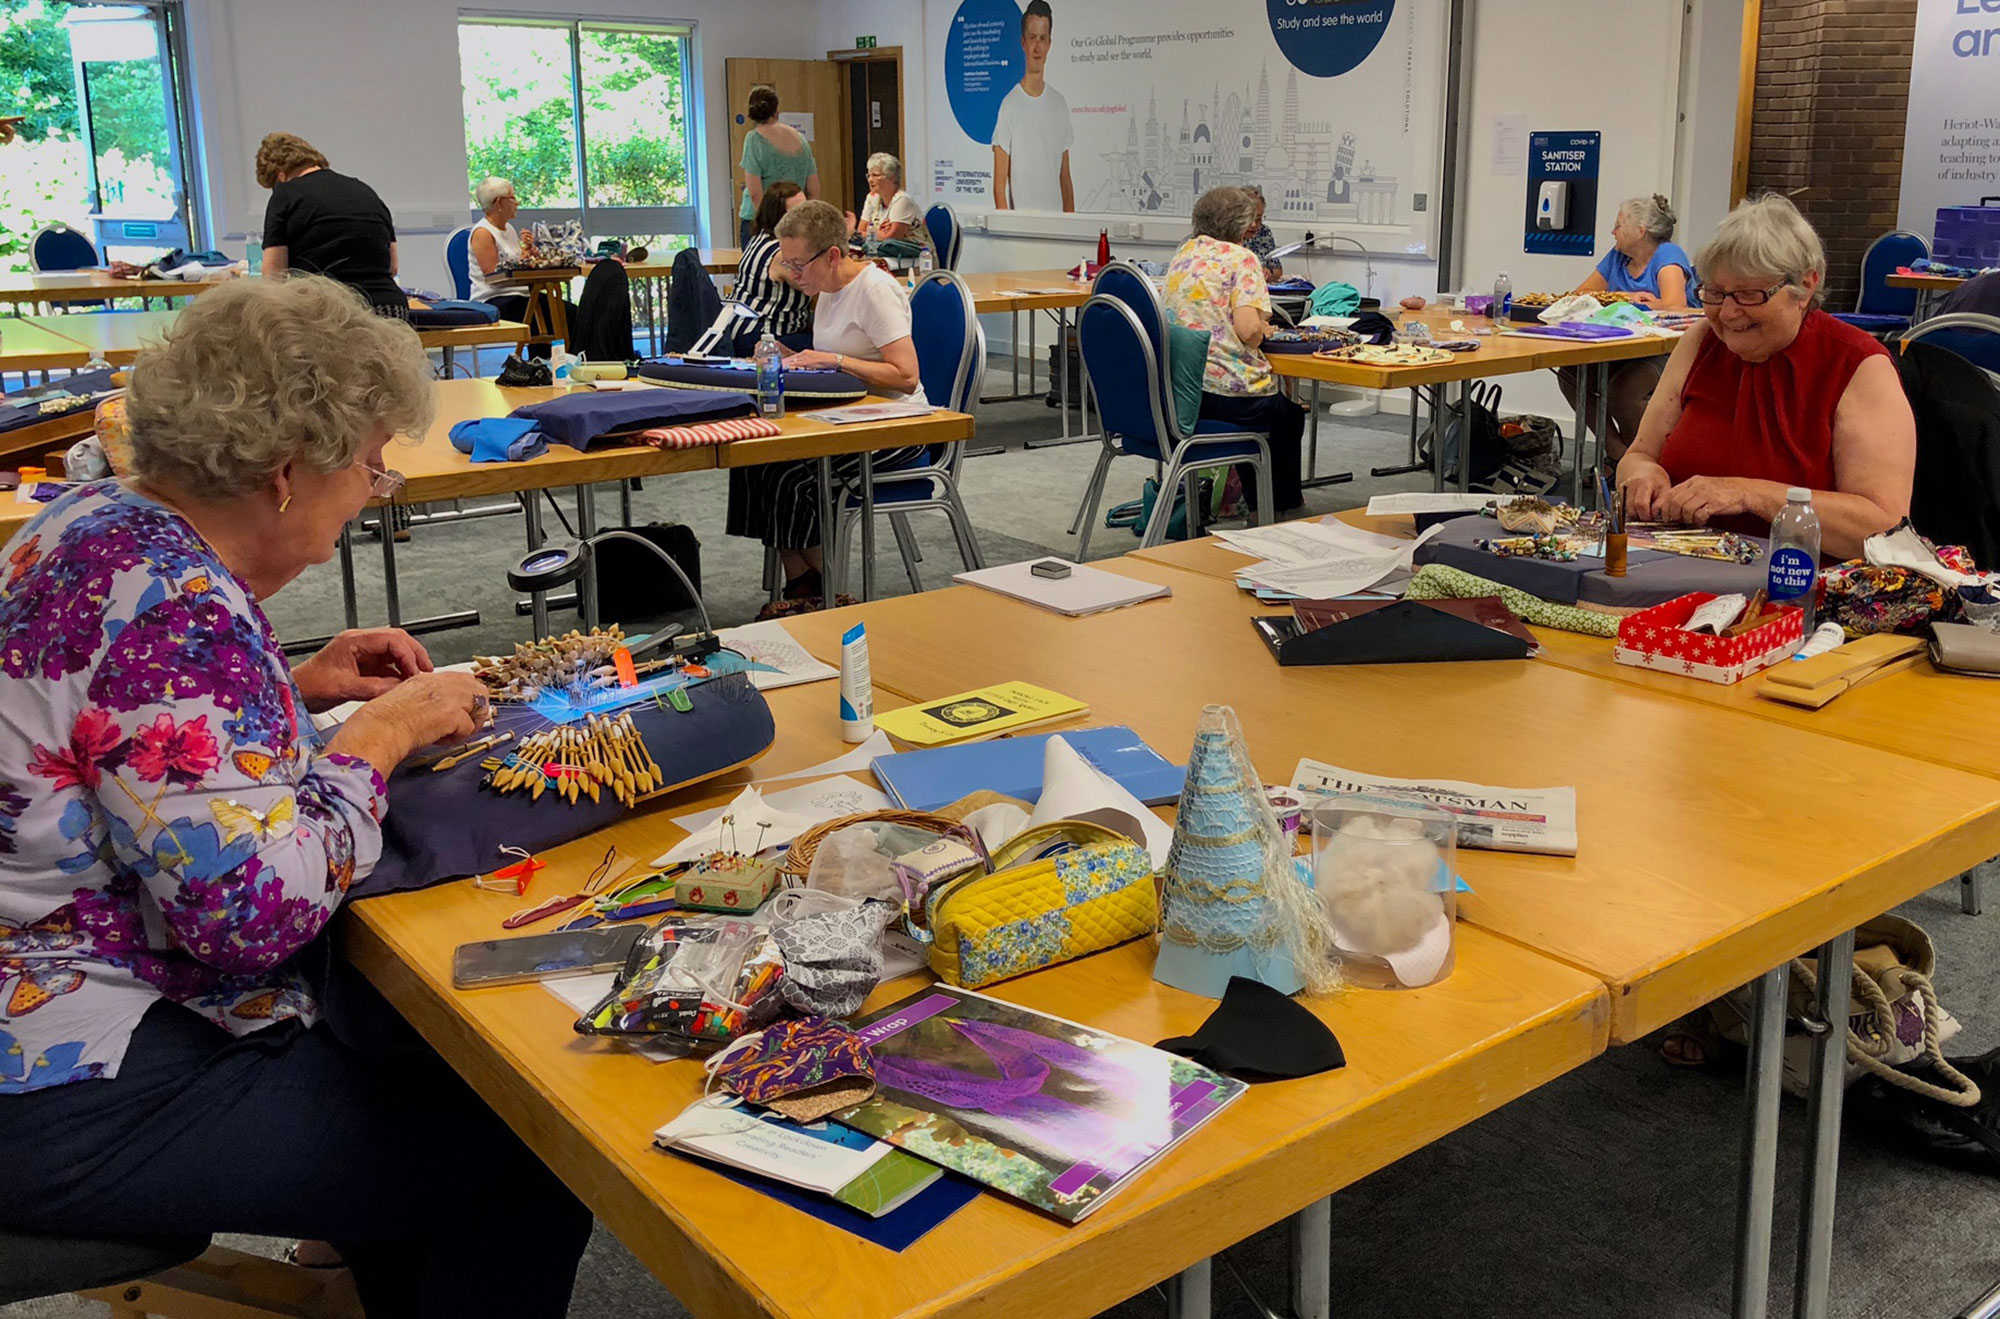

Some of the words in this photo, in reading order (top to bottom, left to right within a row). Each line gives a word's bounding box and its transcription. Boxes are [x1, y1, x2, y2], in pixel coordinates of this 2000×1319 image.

[1277, 17, 1300, 30] Study
[1303, 15, 1320, 27] and
[1322, 17, 1338, 26] see
[1340, 13, 1354, 25] the
[1357, 10, 1383, 23] world
[1071, 38, 1084, 48] Our
[1085, 36, 1095, 47] Go
[1096, 34, 1117, 46] Global
[1118, 34, 1156, 47] Programme
[1157, 30, 1186, 45] provides
[1187, 27, 1235, 43] opportunities
[1071, 54, 1079, 62] to
[1079, 51, 1095, 64] study
[1096, 50, 1109, 61] and
[1121, 49, 1131, 60] the
[1132, 47, 1153, 59] world.
[1941, 136, 1990, 149] adapting
[1542, 151, 1585, 160] SANITISER
[1940, 152, 1986, 165] teaching
[1989, 154, 2000, 163] to
[1545, 162, 1581, 171] STATION
[1938, 169, 1951, 180] of
[1951, 168, 1995, 183] industry
[1781, 554, 1800, 565] i'm
[1770, 565, 1785, 574] not
[1772, 575, 1782, 584] to
[1784, 576, 1807, 586] this
[1317, 775, 1372, 792] THE
[867, 1018, 908, 1037] Wrap
[777, 1132, 828, 1151] Lockdown
